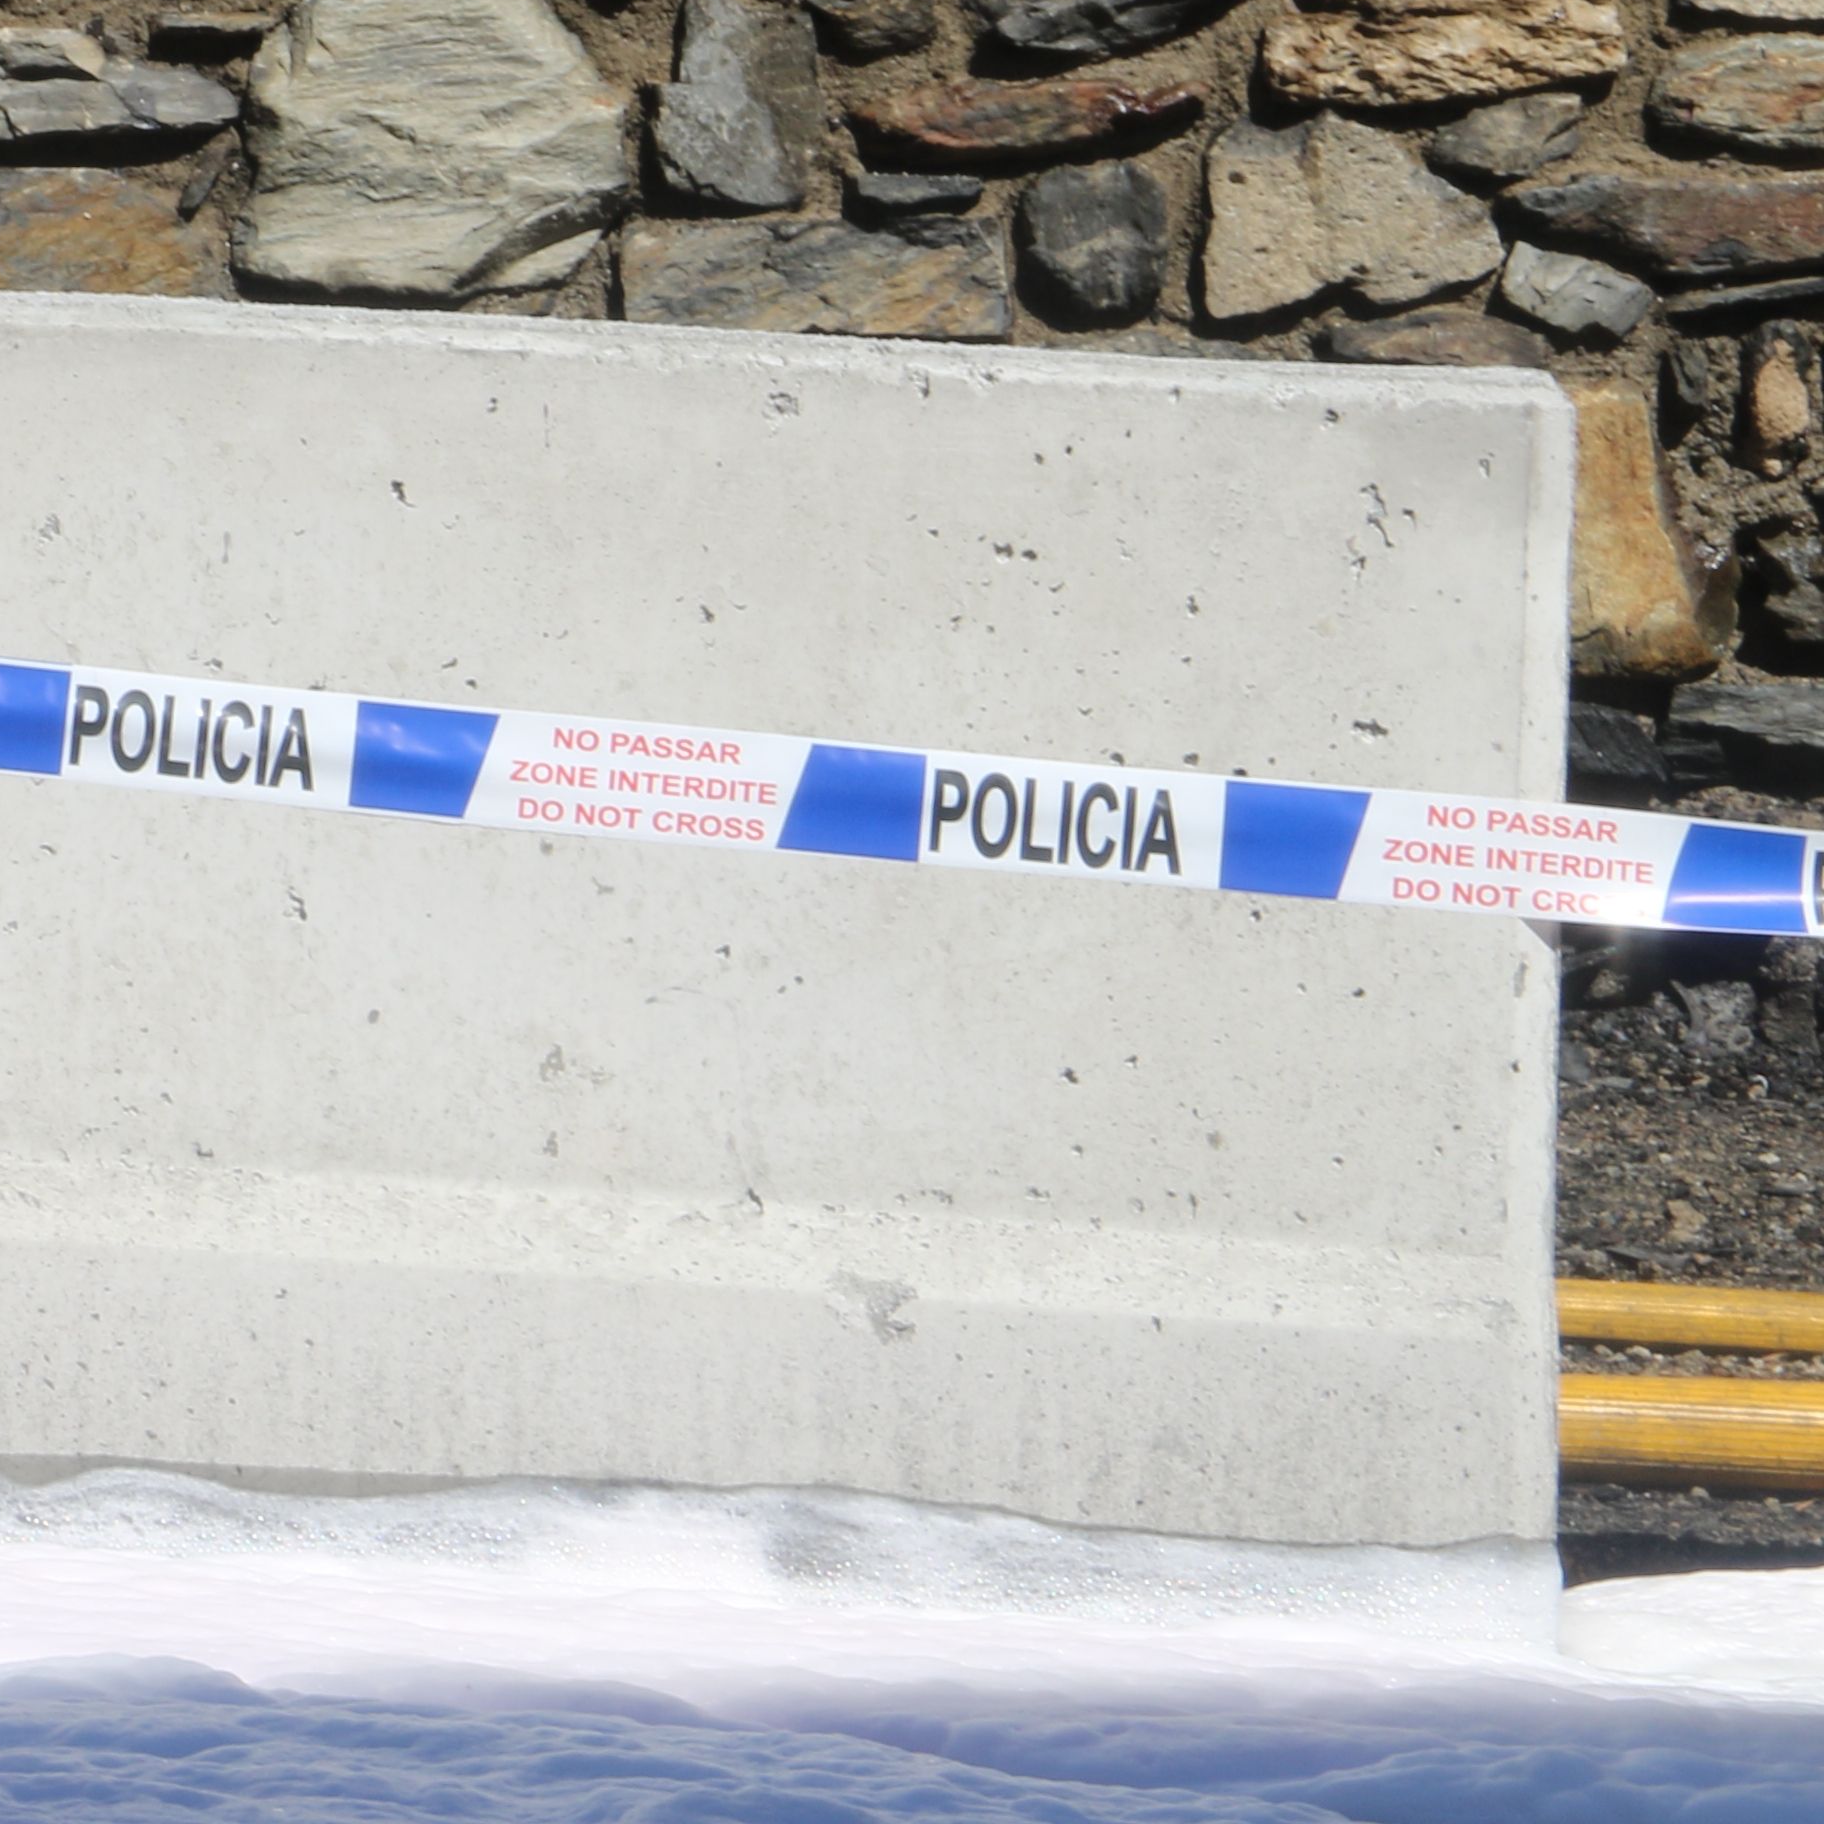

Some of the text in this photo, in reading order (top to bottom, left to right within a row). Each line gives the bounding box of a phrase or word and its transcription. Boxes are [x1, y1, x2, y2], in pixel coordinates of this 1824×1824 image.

[69, 684, 314, 792] POLICIA
[553, 727, 741, 765] NO PASSAR
[510, 760, 777, 805] ZONE INTERDITE
[517, 797, 765, 841] DO NOT CROSS
[929, 768, 1182, 876] POLICIA
[1427, 805, 1618, 844] NO PASSAR
[1382, 838, 1654, 884] ZONE INTERDITE
[1392, 876, 1440, 901] DO
[1452, 883, 1521, 908] NOT
